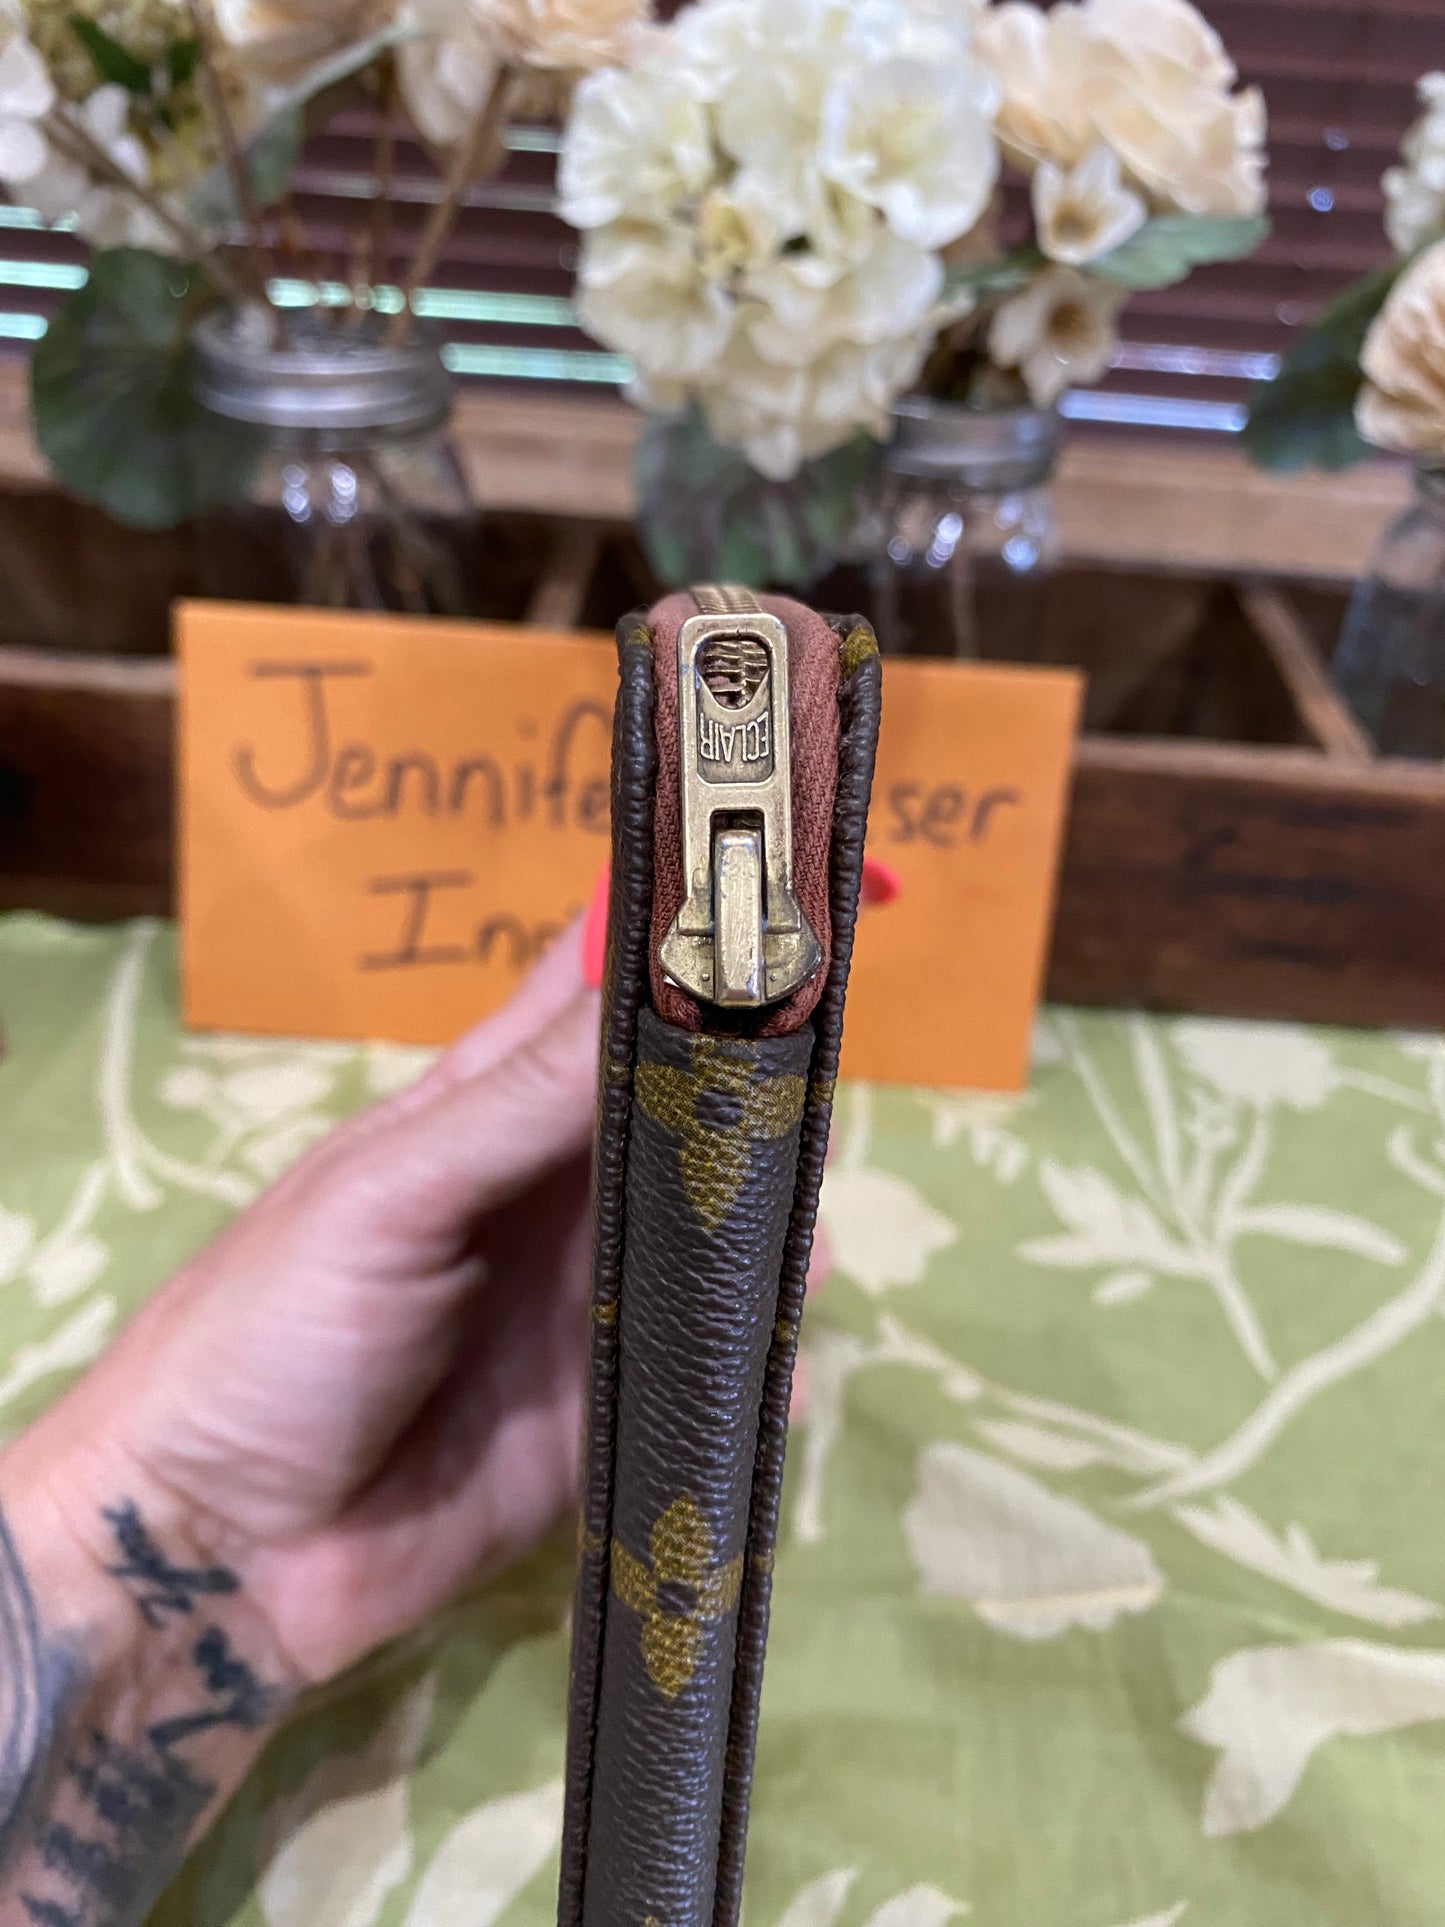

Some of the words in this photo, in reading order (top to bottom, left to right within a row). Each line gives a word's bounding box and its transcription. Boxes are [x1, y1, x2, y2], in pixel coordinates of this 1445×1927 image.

[231, 658, 614, 836] Jennife
[882, 777, 1021, 849] ser
[699, 710, 770, 763] ECLAIR
